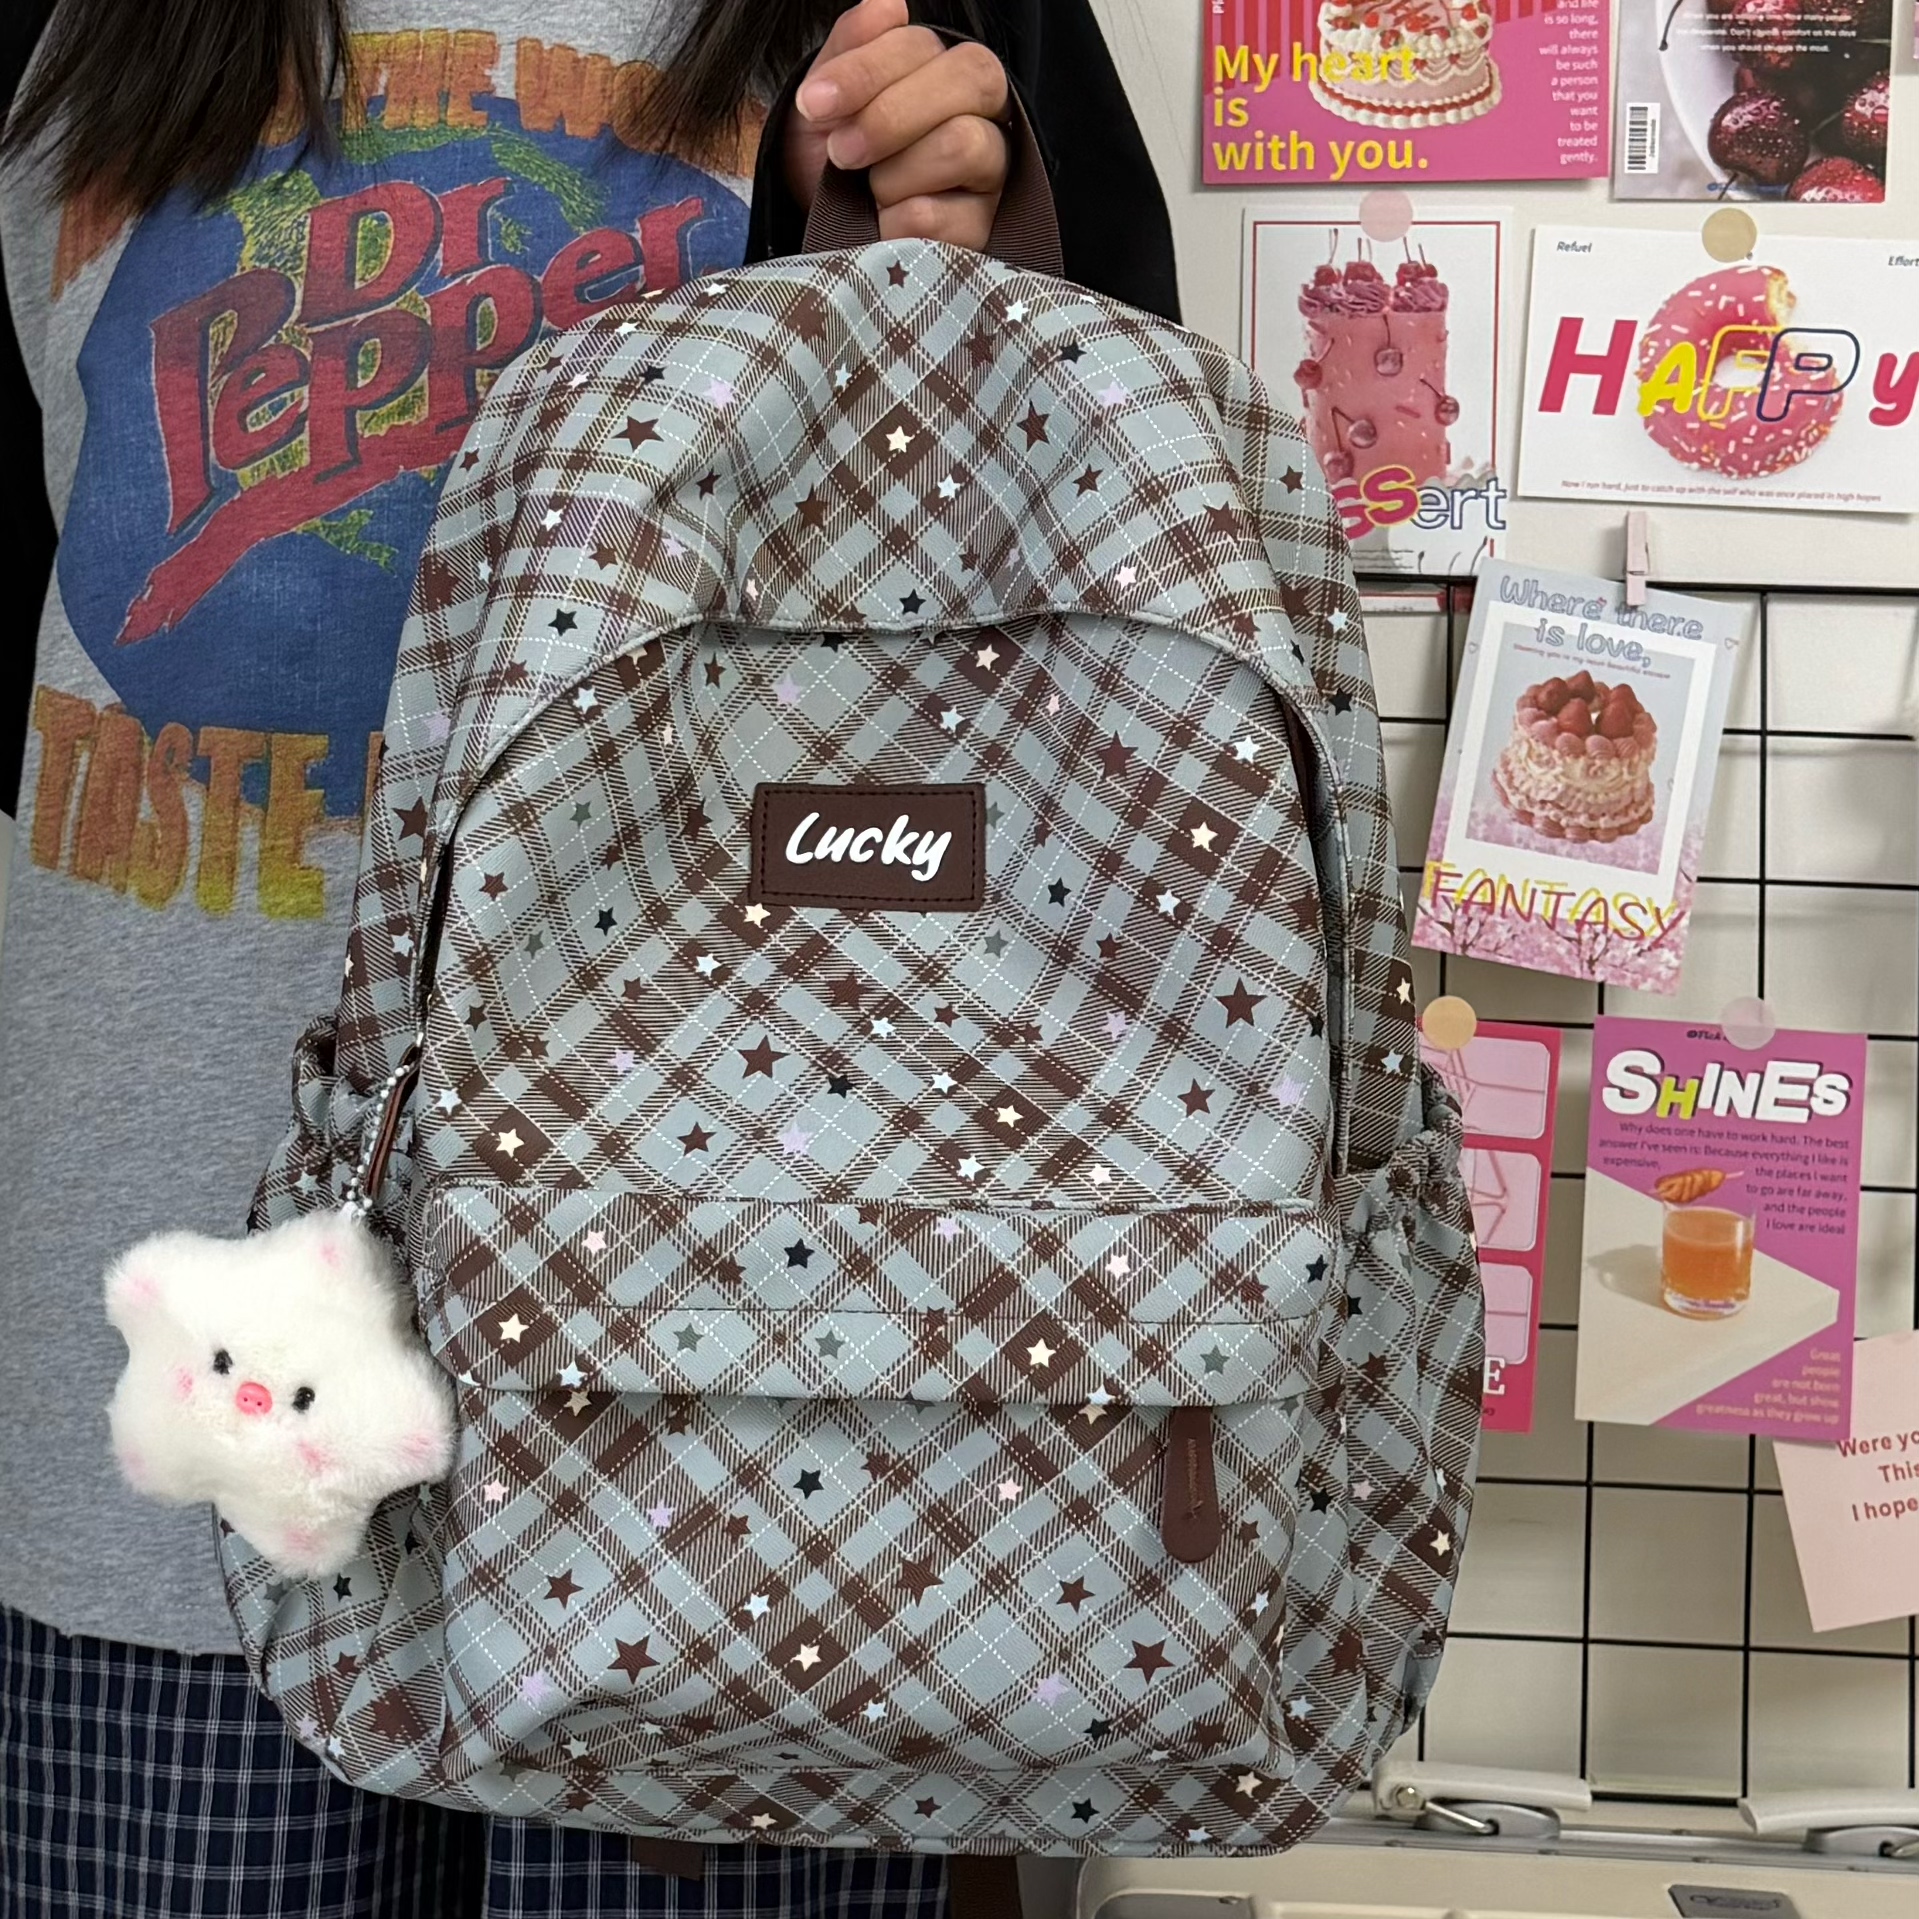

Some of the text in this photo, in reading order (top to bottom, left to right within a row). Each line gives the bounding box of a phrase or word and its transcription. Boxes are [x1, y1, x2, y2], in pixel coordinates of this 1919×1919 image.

[1544, 15, 1554, 24] is
[1556, 16, 1569, 24] so
[1569, 29, 1598, 39] there
[1539, 44, 1598, 57] will always
[1214, 41, 1417, 93] My heart
[1556, 60, 1598, 71] be such
[1551, 76, 1598, 88] a person
[1213, 86, 1250, 127] is
[1552, 91, 1598, 103] that you
[1570, 107, 1598, 116] want
[1570, 121, 1598, 132] to be
[1557, 136, 1598, 147] treated
[1211, 130, 1429, 182] with you.
[1557, 241, 1592, 253] Refuel
[149, 196, 704, 538] Pepper
[1500, 575, 1603, 621] Where
[1534, 618, 1651, 668] is love,
[30, 685, 329, 919] TASTE
[785, 812, 952, 882] Lucky
[1422, 860, 1685, 948] FANTASY
[1620, 1122, 1642, 1135] Why
[1645, 1124, 1671, 1136] does
[1674, 1128, 1696, 1137] one
[1698, 1128, 1724, 1139] have
[1726, 1131, 1738, 1140] to
[1740, 1132, 1767, 1141] work
[1803, 1135, 1823, 1147] The
[1825, 1138, 1849, 1149] best
[1599, 1139, 1638, 1149] answer
[1661, 1143, 1687, 1154] seen
[1704, 1145, 1748, 1158] Because
[1751, 1150, 1810, 1166] everything
[1818, 1154, 1837, 1165] like
[1839, 1157, 1848, 1166] is
[1755, 1167, 1773, 1177] the
[1776, 1169, 1811, 1180] places
[1820, 1174, 1848, 1182] want
[1746, 1184, 1758, 1194] to
[1760, 1185, 1774, 1196] go
[1777, 1187, 1794, 1196] are
[1797, 1186, 1813, 1197] far
[1763, 1203, 1846, 1218] and the people
[1772, 1218, 1796, 1230] love
[1798, 1223, 1816, 1233] are
[1818, 1224, 1846, 1235] ideal
[1772, 1378, 1790, 1389] are
[1696, 1404, 1840, 1425] greatness as they grow up
[1835, 1436, 1892, 1458] Were
[1877, 1460, 1919, 1483] This
[1851, 1497, 1919, 1522] I hope
